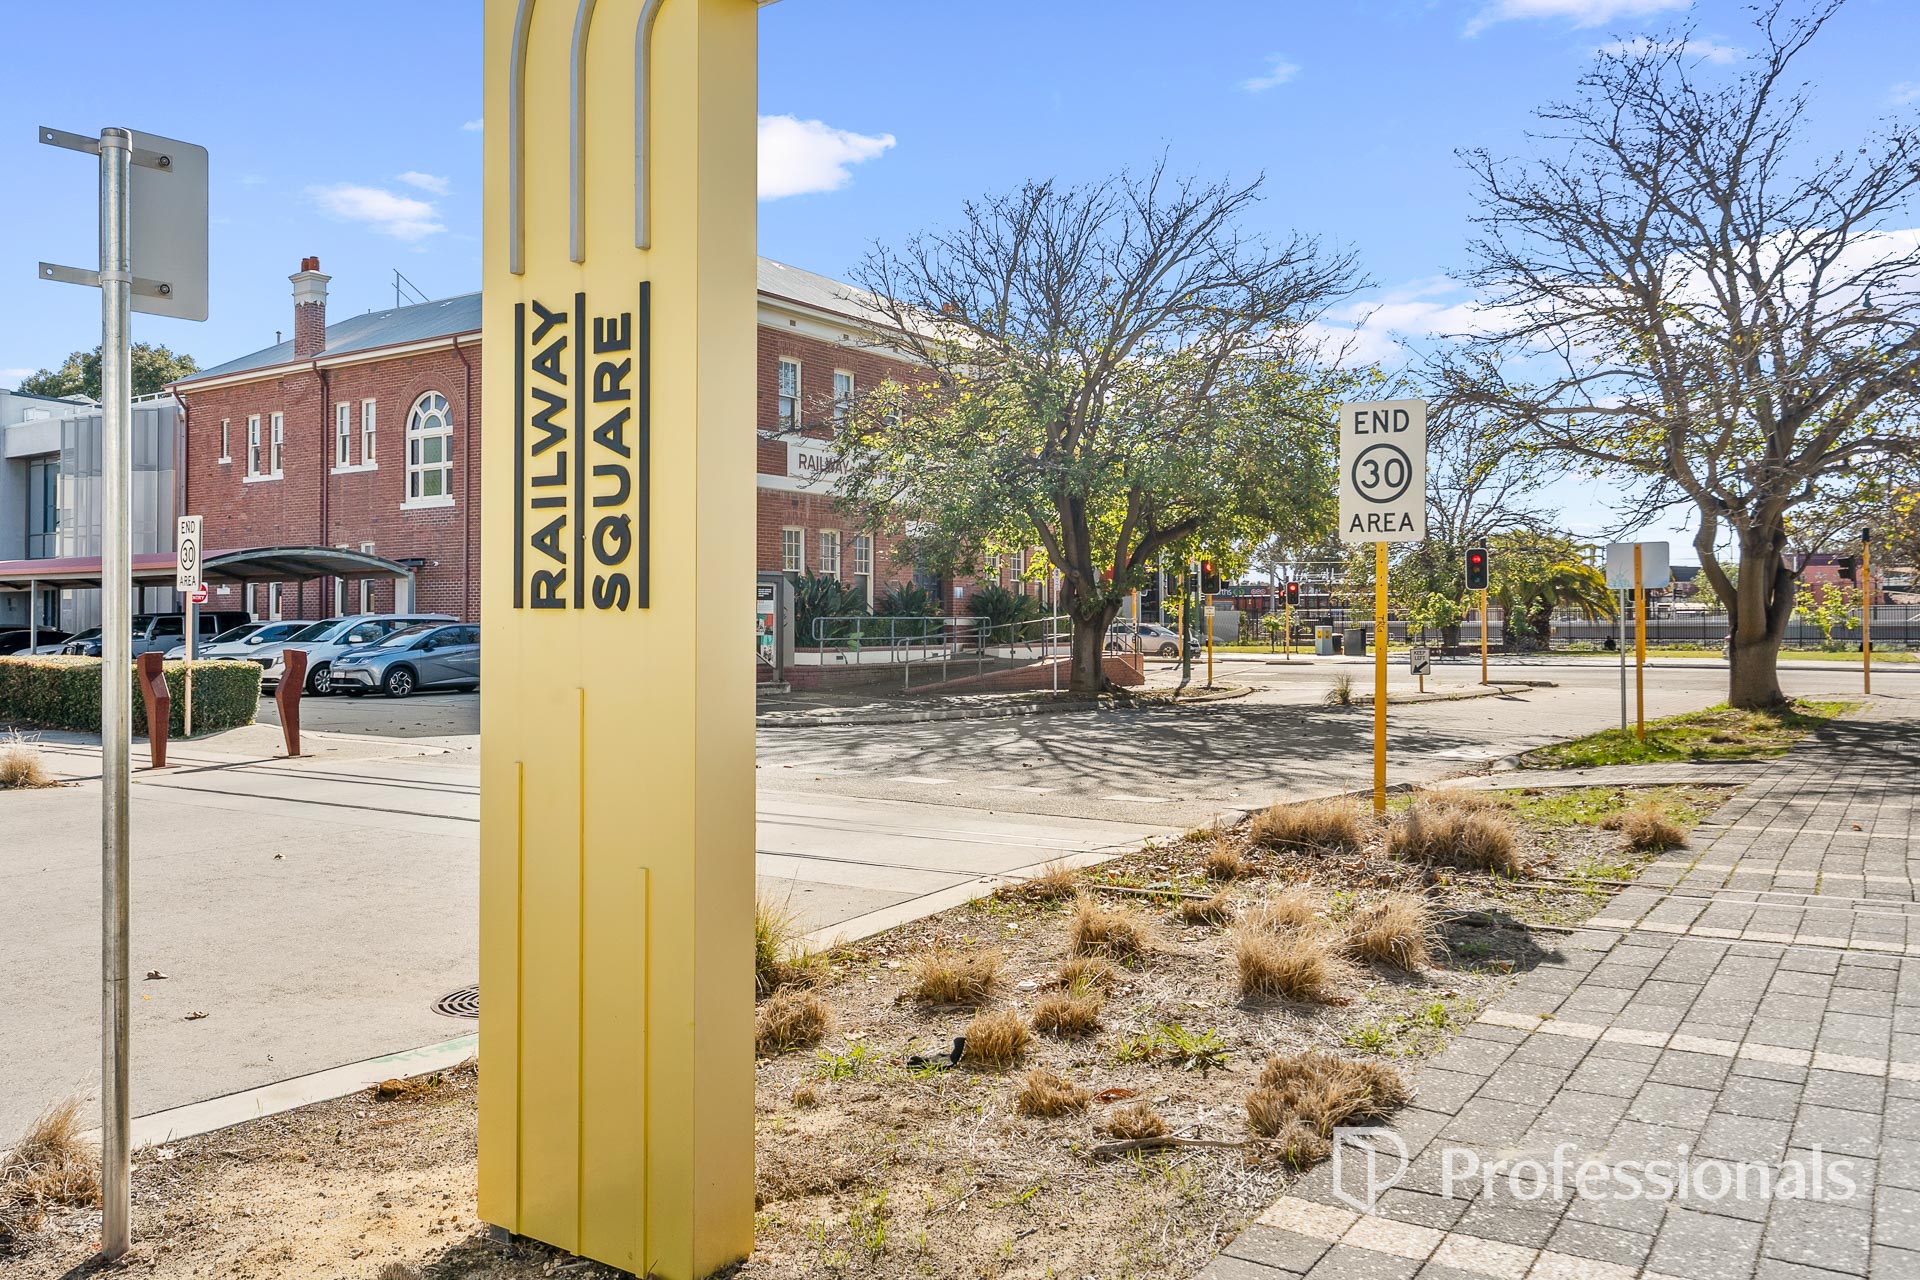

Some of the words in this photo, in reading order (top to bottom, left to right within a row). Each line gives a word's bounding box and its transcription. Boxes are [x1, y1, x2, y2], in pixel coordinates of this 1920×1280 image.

[1354, 409, 1410, 435] END
[530, 299, 567, 609] RAILWAY
[592, 312, 632, 612] SQUARE
[798, 453, 850, 475] RAILWAY
[1361, 458, 1404, 489] 30
[181, 521, 196, 534] END
[1349, 512, 1414, 533] AREA
[182, 546, 194, 563] 30
[180, 575, 196, 587] AREA
